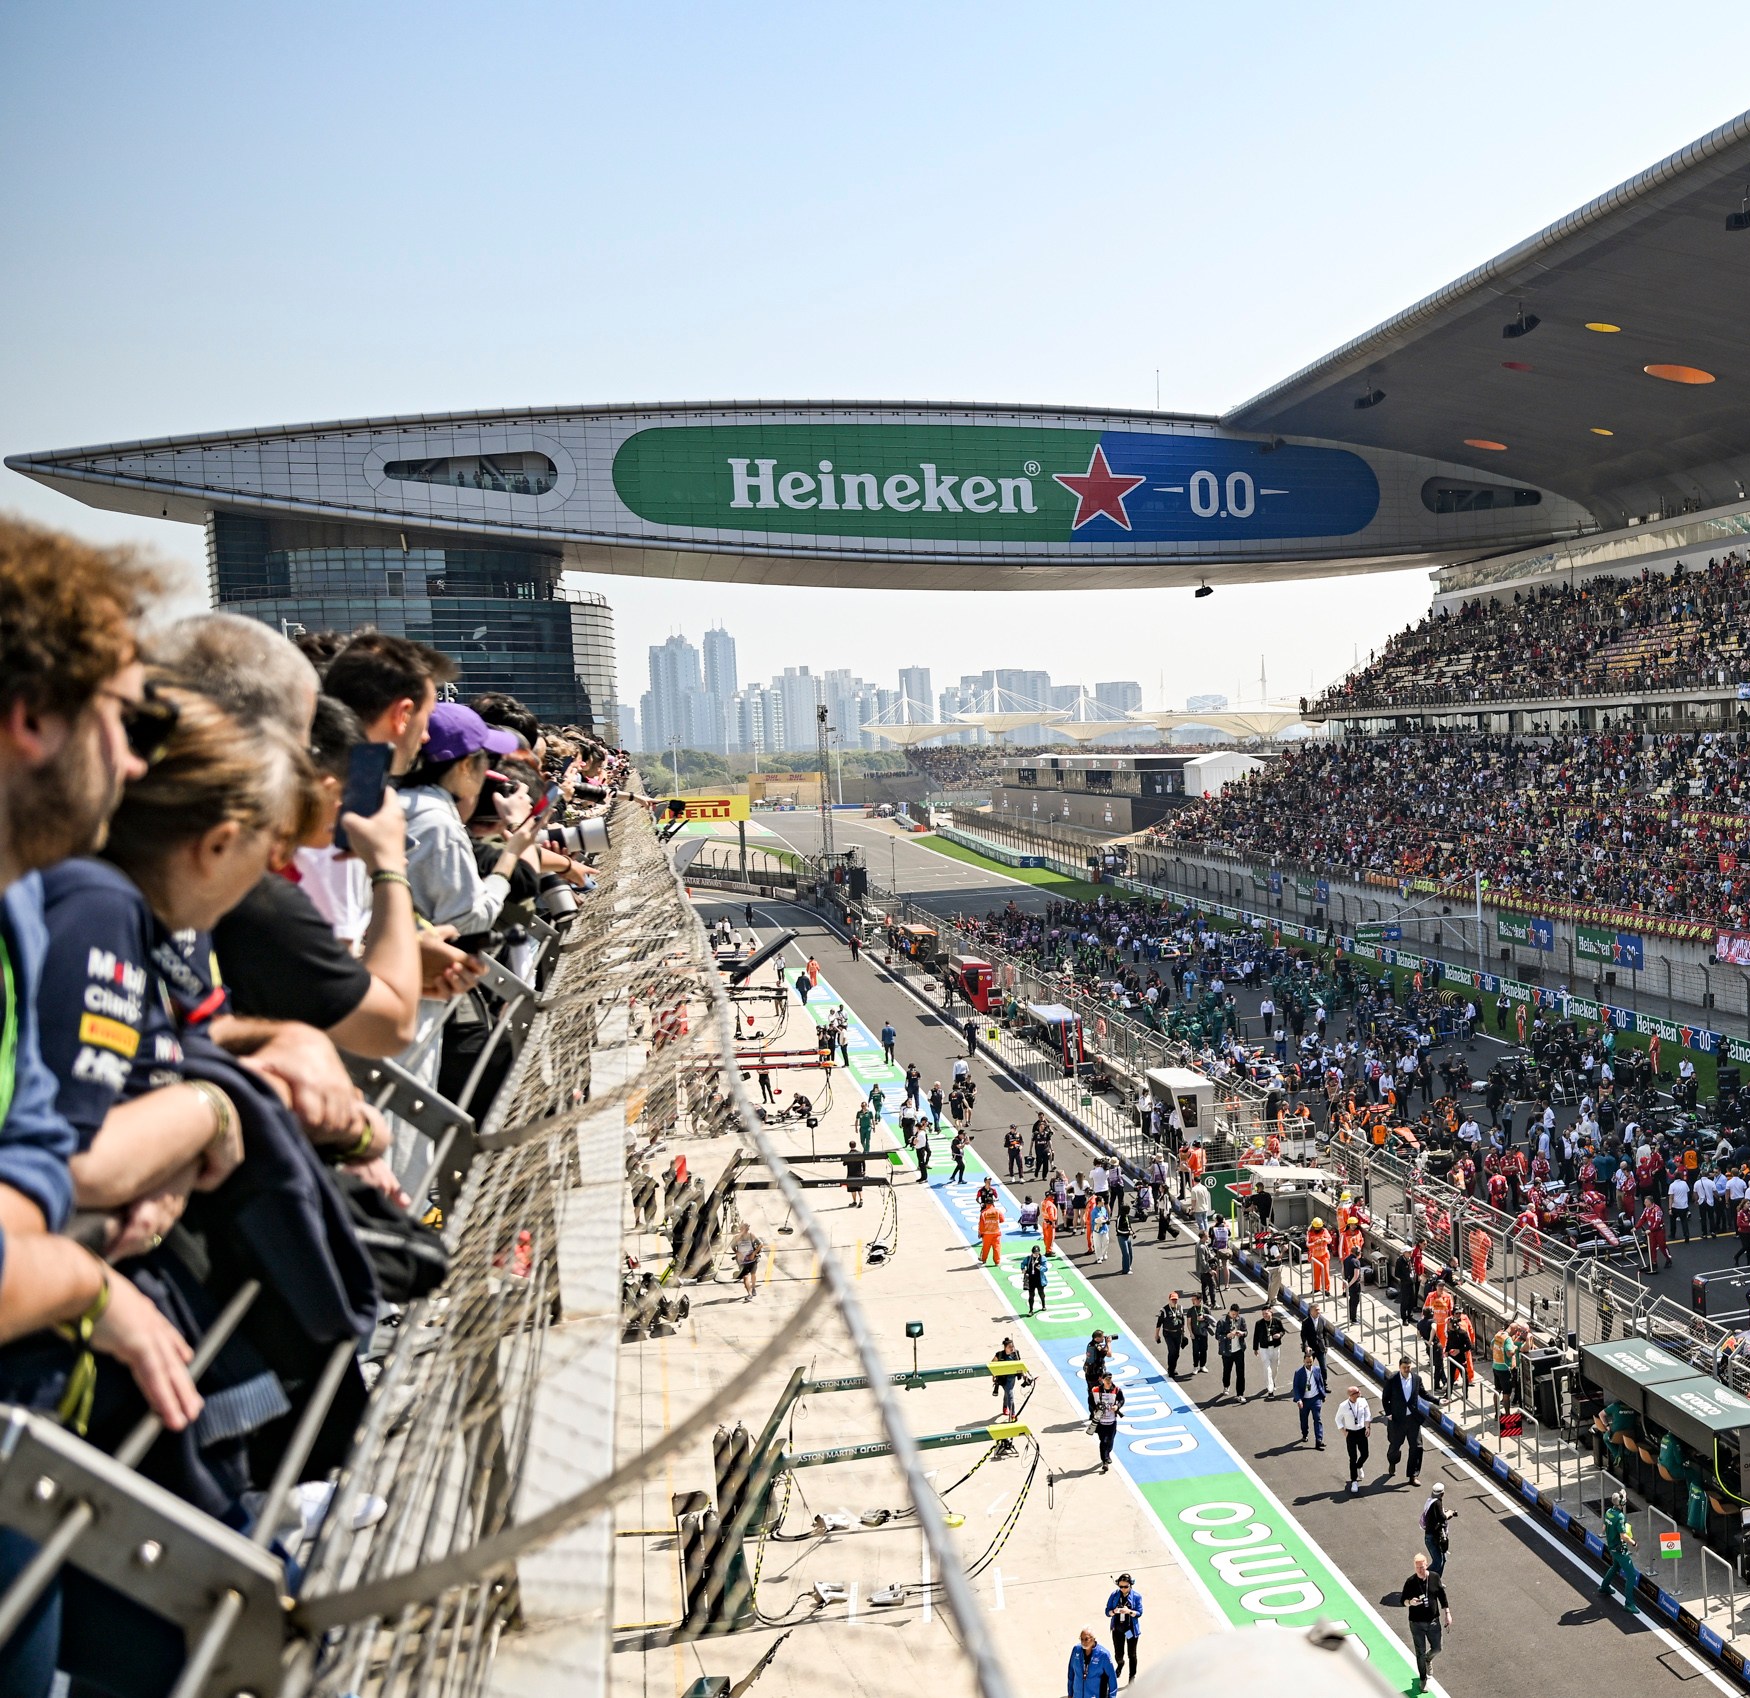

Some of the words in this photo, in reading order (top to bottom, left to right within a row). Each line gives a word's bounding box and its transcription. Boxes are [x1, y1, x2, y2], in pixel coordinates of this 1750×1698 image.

[730, 459, 1039, 514] Heineken
[1189, 470, 1255, 518] 0.0
[958, 1367, 974, 1375] arm
[955, 1432, 972, 1440] arm
[826, 1449, 858, 1459] MARTIN
[860, 1443, 893, 1454] aramc
